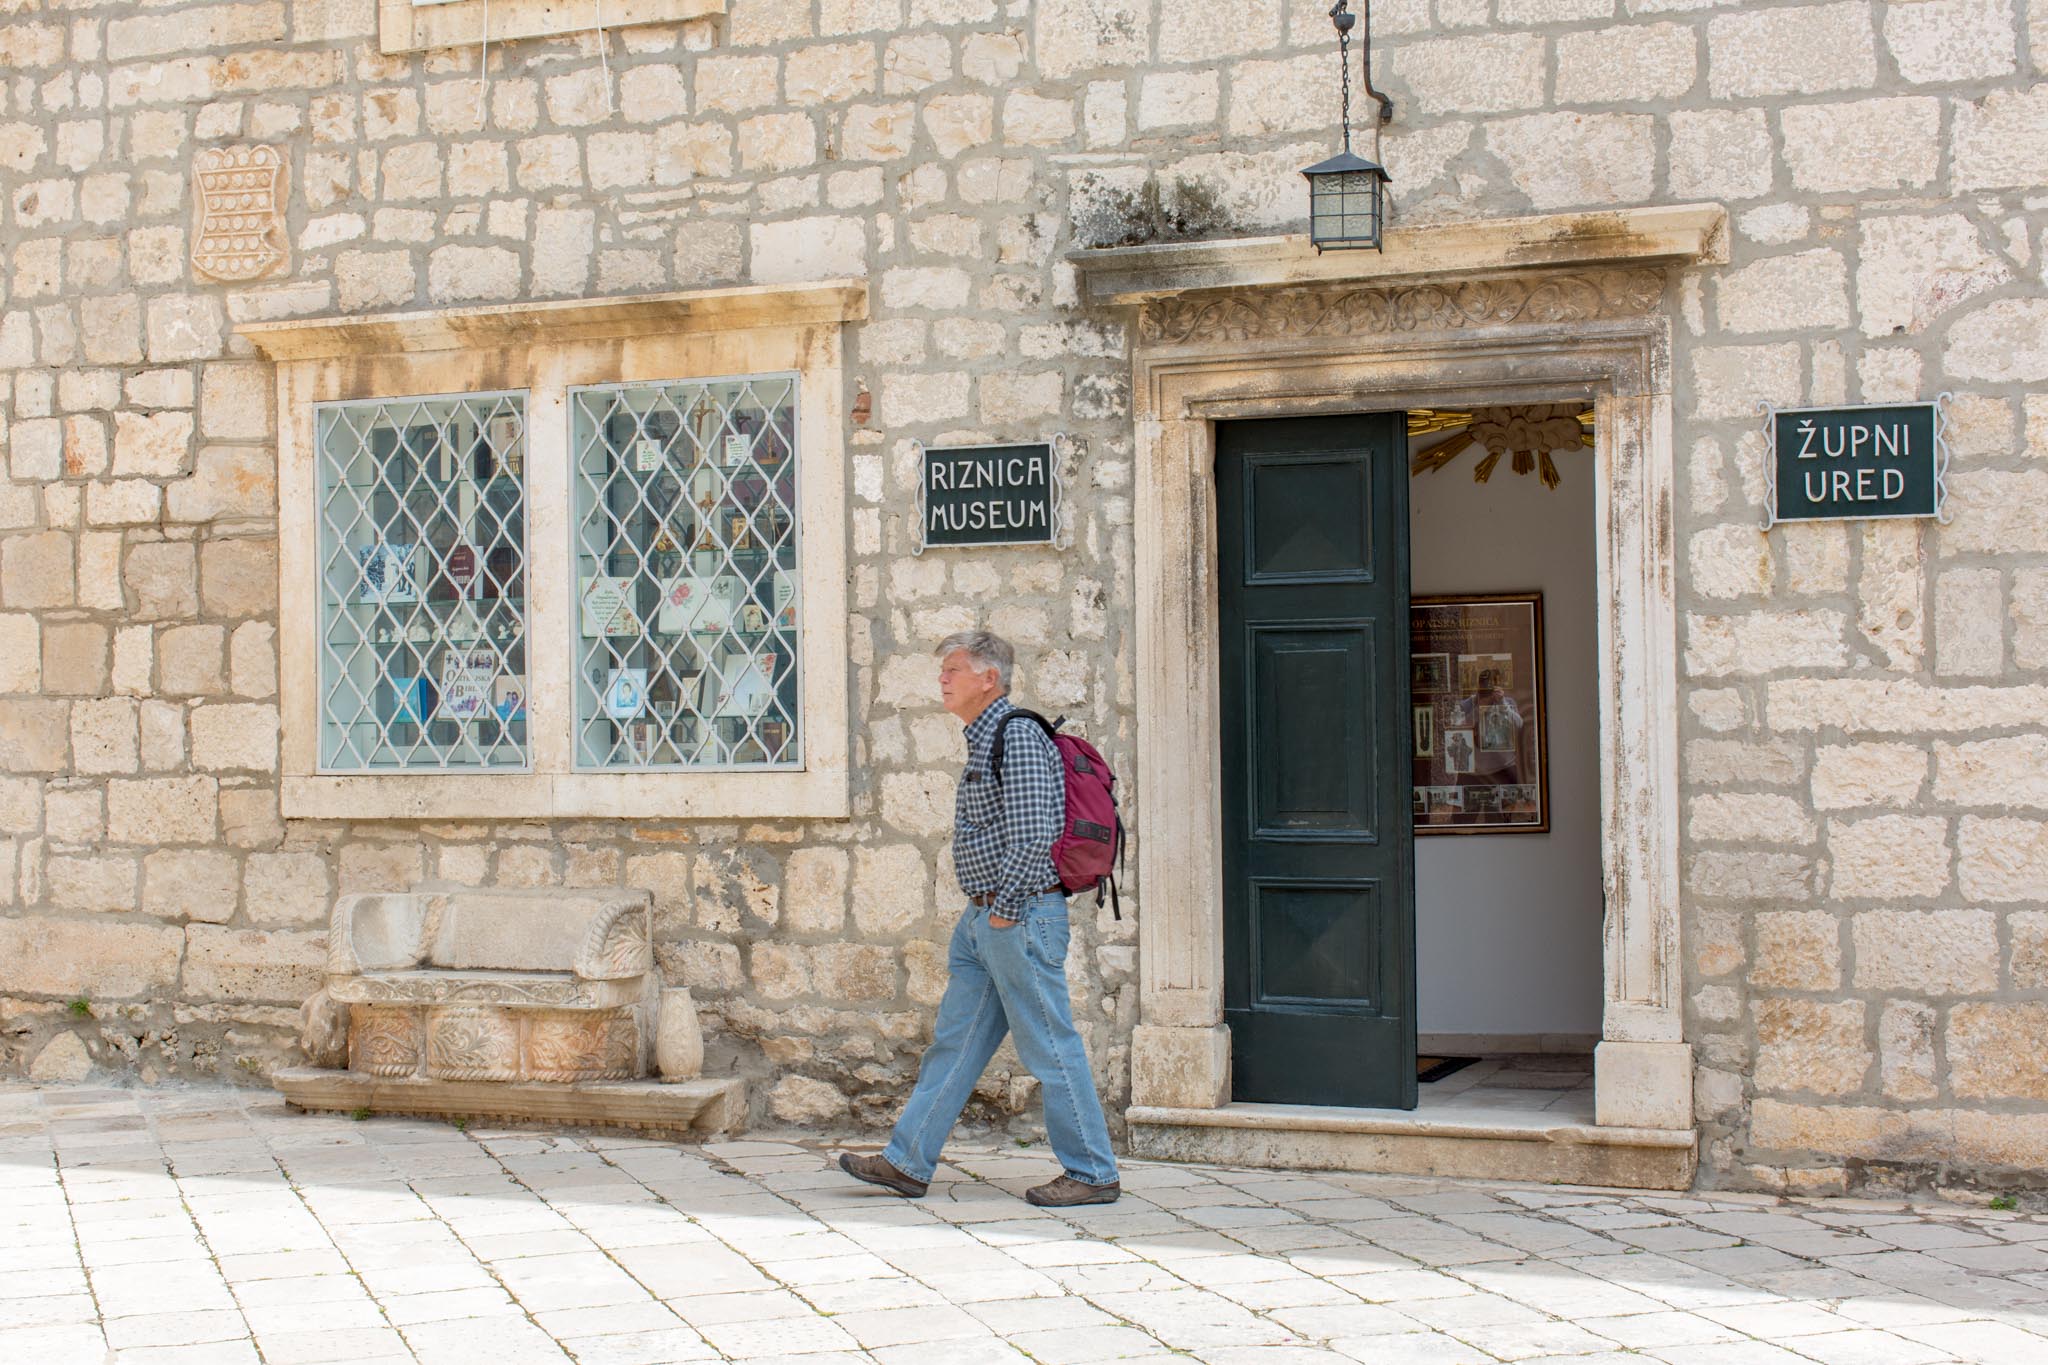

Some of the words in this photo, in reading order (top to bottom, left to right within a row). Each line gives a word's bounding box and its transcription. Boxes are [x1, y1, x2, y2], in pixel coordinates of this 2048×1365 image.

[1796, 419, 1910, 459] ŽUPNI
[931, 457, 1045, 491] RIZNICA
[1804, 468, 1905, 503] URED
[930, 499, 1047, 531] MUSEUM
